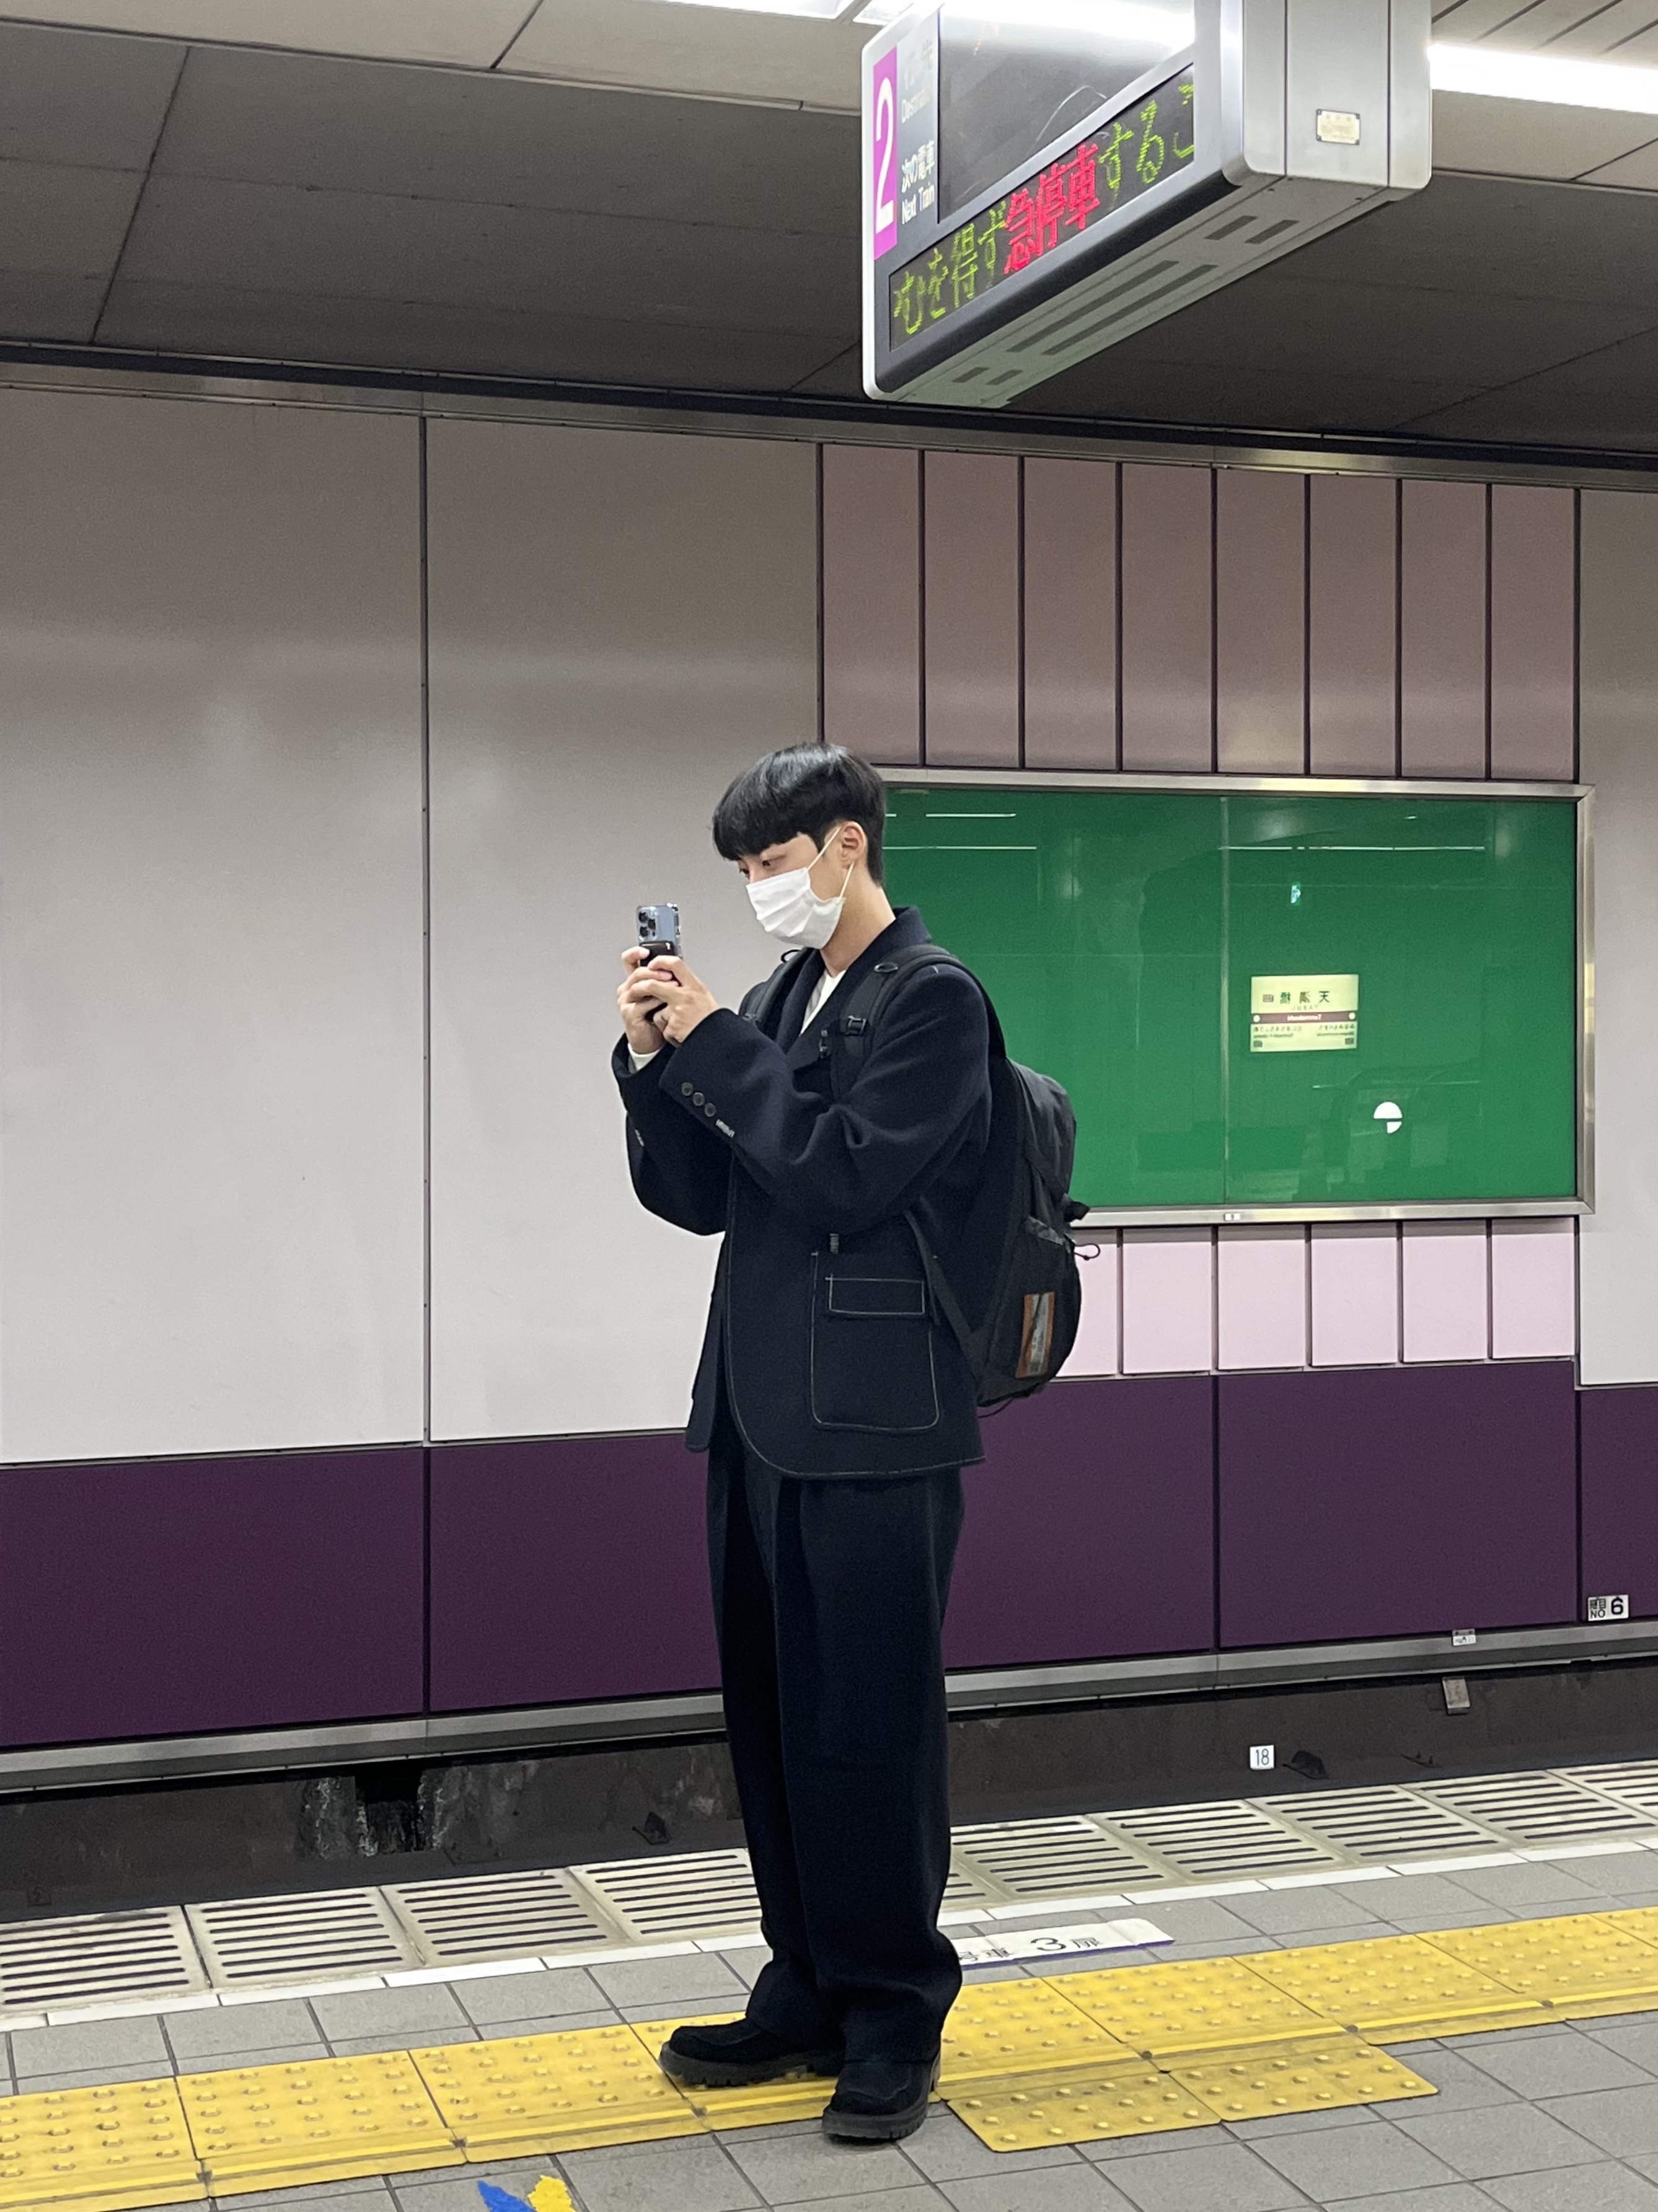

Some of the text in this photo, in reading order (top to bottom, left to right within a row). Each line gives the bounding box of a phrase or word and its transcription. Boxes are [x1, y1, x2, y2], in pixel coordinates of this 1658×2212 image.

[875, 77, 894, 234] 2
[901, 139, 935, 193] 次の電車
[901, 180, 935, 225] Next Train
[1611, 1597, 1623, 1615] 6
[1256, 1748, 1269, 1766] 18
